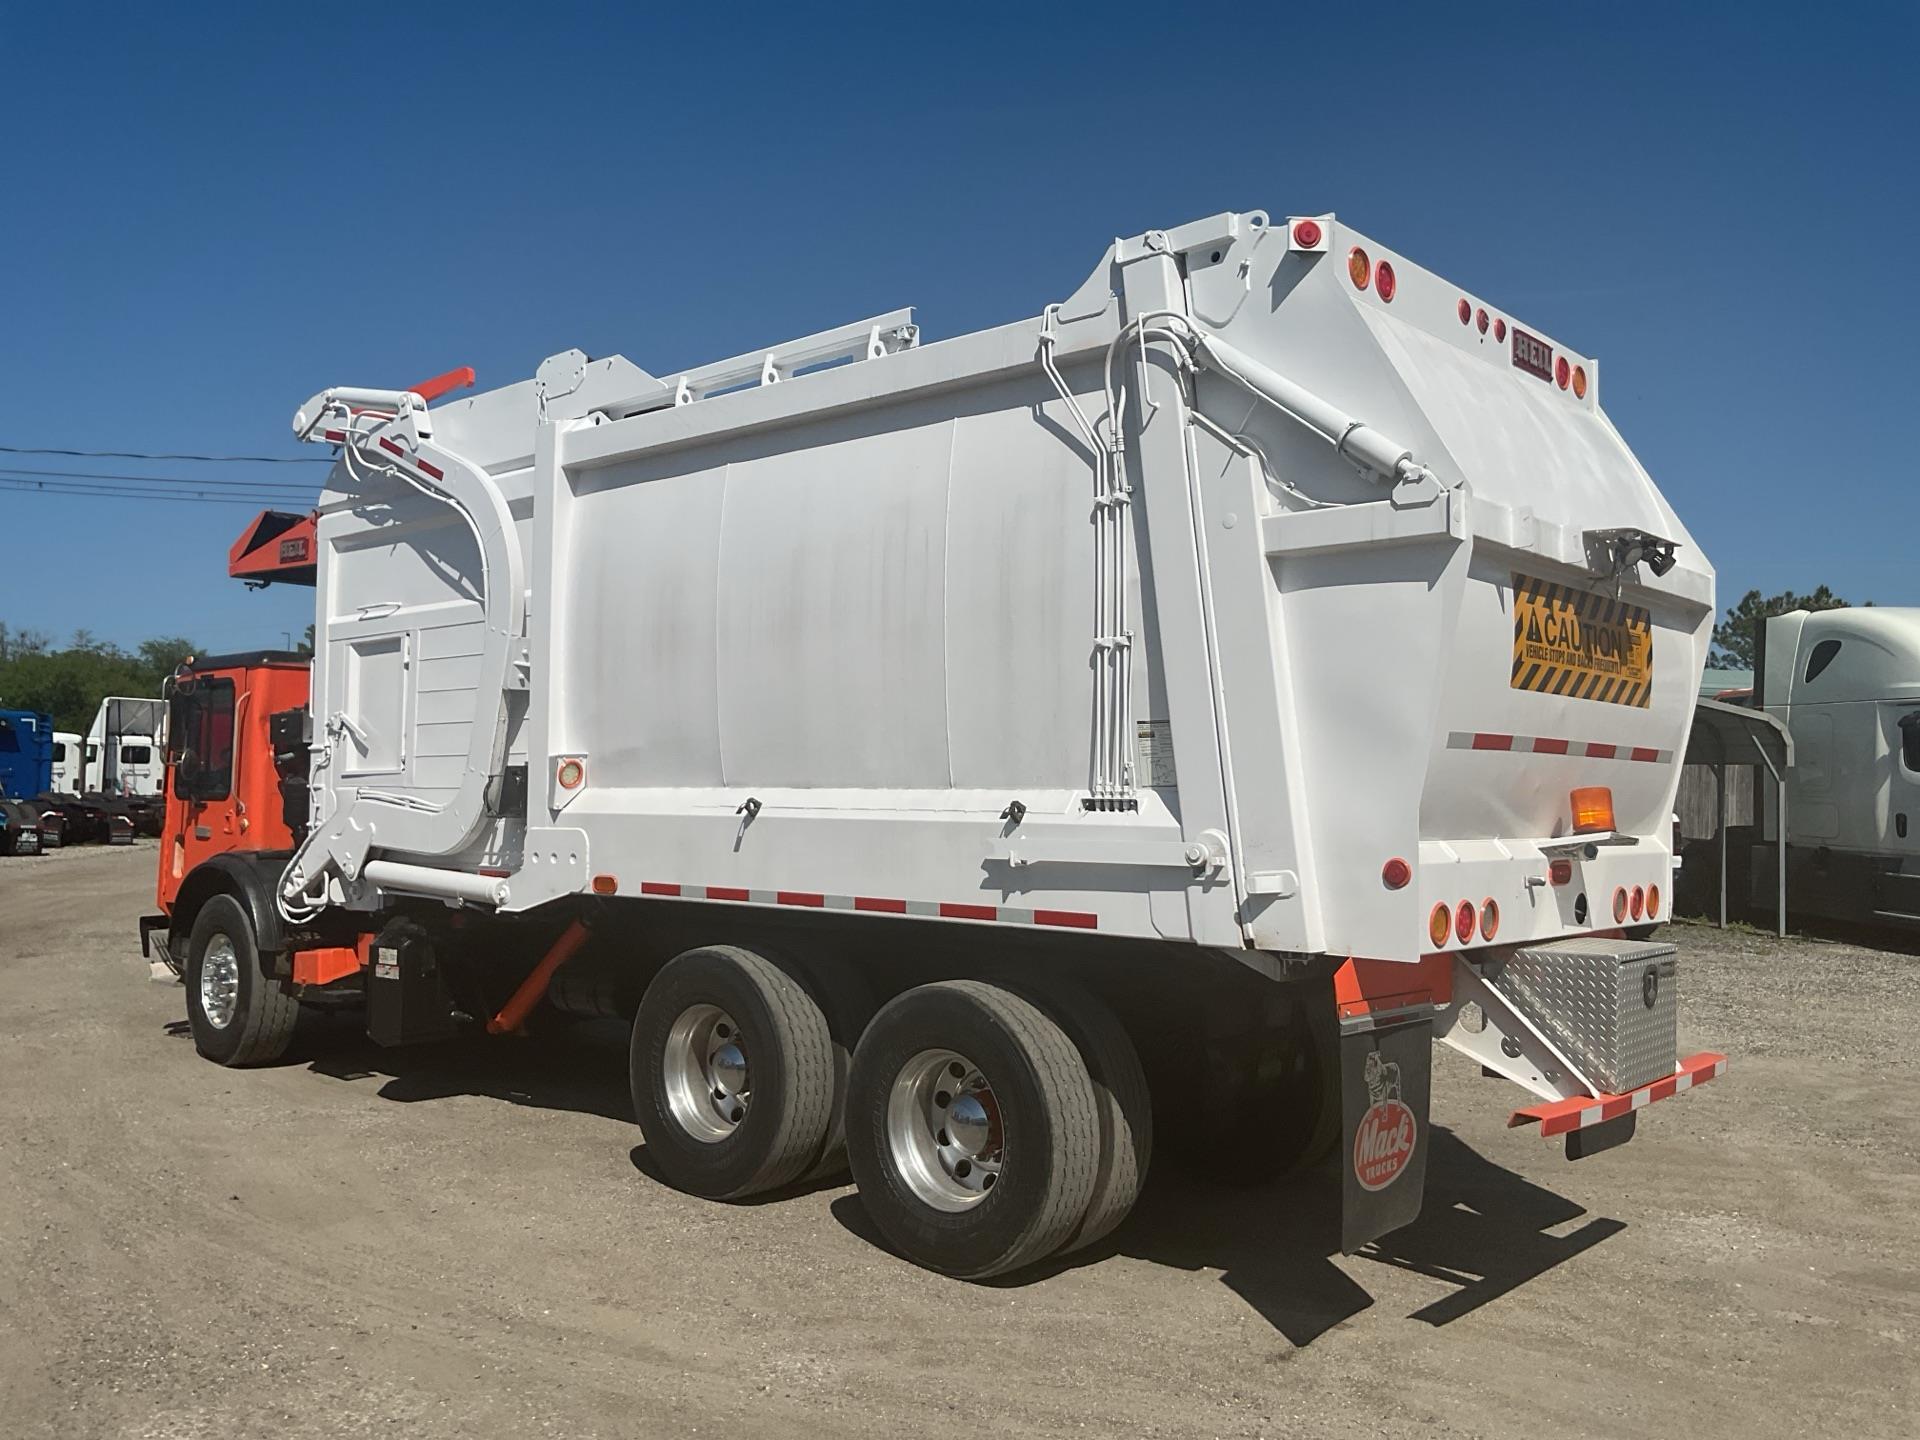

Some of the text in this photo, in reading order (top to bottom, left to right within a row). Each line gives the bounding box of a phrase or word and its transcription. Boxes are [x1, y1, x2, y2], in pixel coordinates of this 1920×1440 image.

[1515, 333, 1552, 372] HEIL
[1526, 643, 1549, 661] VEHICLE
[1545, 612, 1622, 661] CAUTION
[1358, 1113, 1410, 1166] Mack
[1366, 1157, 1398, 1181] TRUCKS
